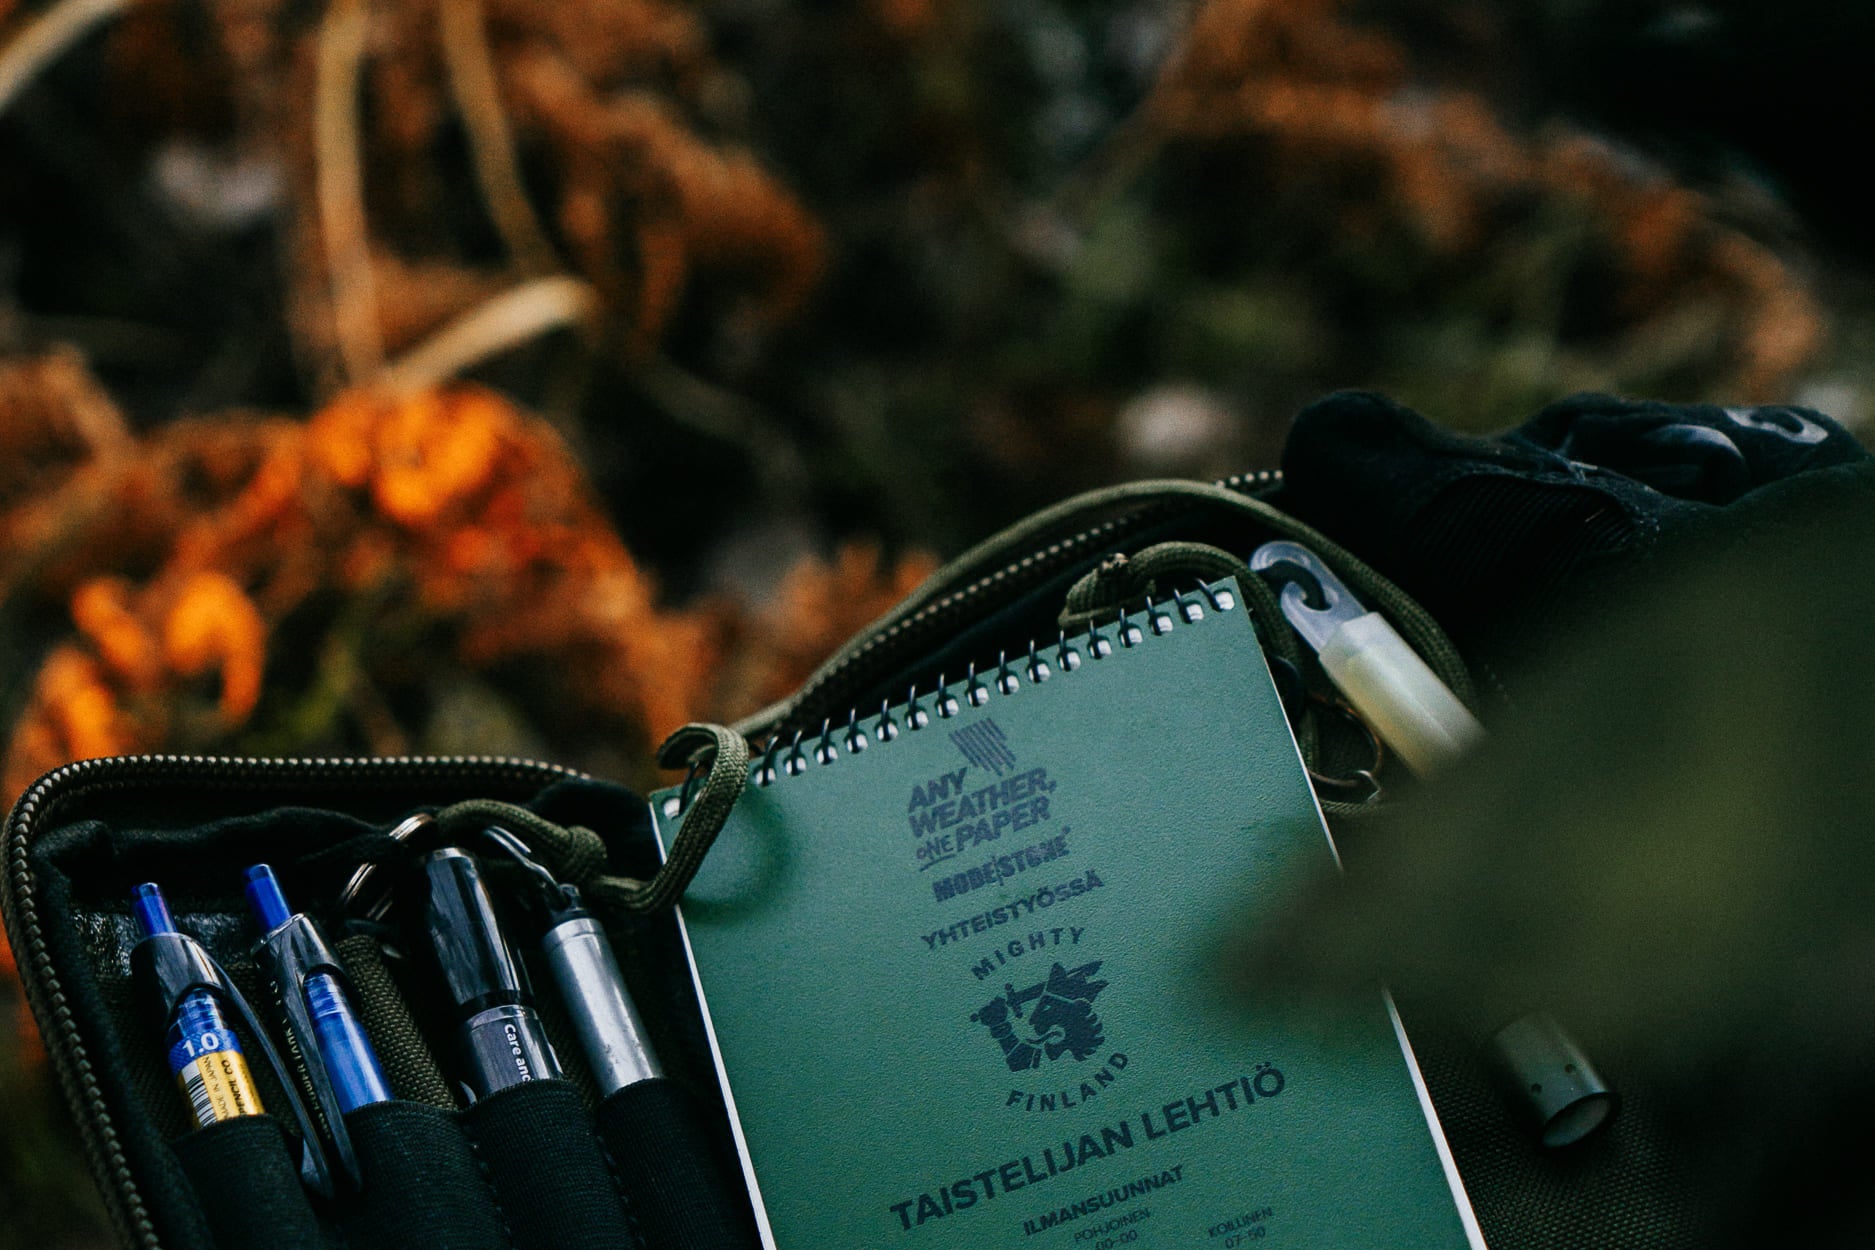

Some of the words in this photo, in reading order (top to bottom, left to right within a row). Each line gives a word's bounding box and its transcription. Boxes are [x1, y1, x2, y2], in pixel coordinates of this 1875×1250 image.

[907, 766, 968, 813] ANY
[908, 767, 1057, 838] WEATHER,
[956, 795, 1051, 853] PAPER
[920, 868, 1104, 950] YHTEISTYÖSSÄ
[970, 925, 1085, 981] MIGHTY
[182, 1031, 219, 1058] 1.0
[503, 1022, 523, 1056] Care
[1005, 1052, 1129, 1112] FINLAND
[889, 1120, 1135, 1231] TAISTELIJAN
[1140, 1061, 1286, 1142] LEHTIÖ
[1023, 1164, 1184, 1237] ILMANSUUNNAT
[1073, 1207, 1151, 1244] POHJOINEN
